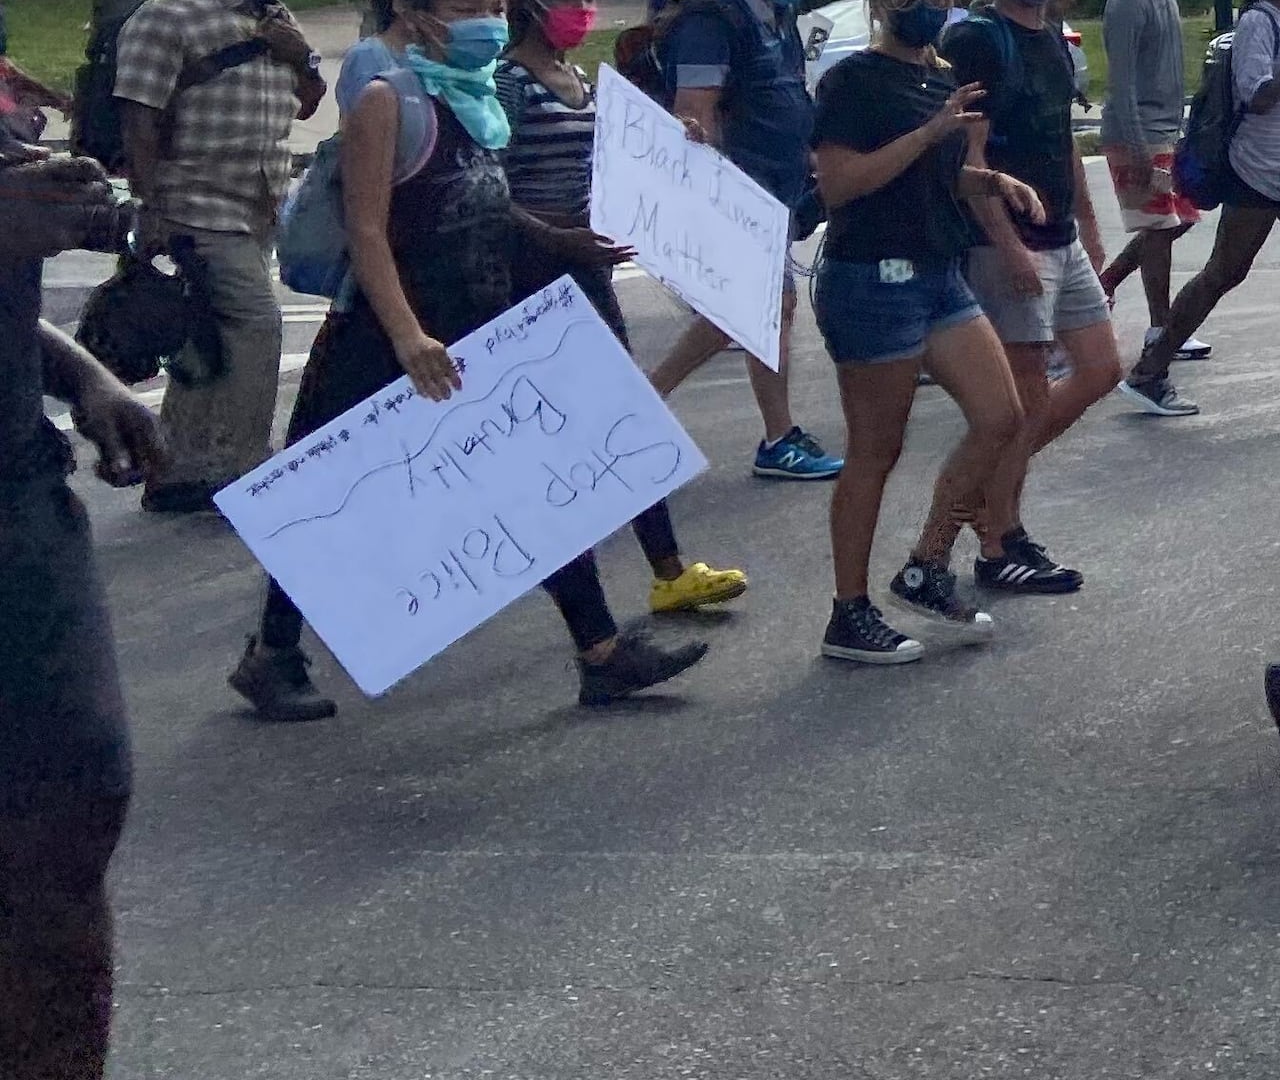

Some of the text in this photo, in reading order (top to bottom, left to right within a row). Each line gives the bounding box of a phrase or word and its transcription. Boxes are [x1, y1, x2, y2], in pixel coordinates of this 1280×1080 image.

[627, 193, 731, 291] Matter
[401, 374, 567, 498] Brutality
[396, 413, 681, 617] Stop Police
